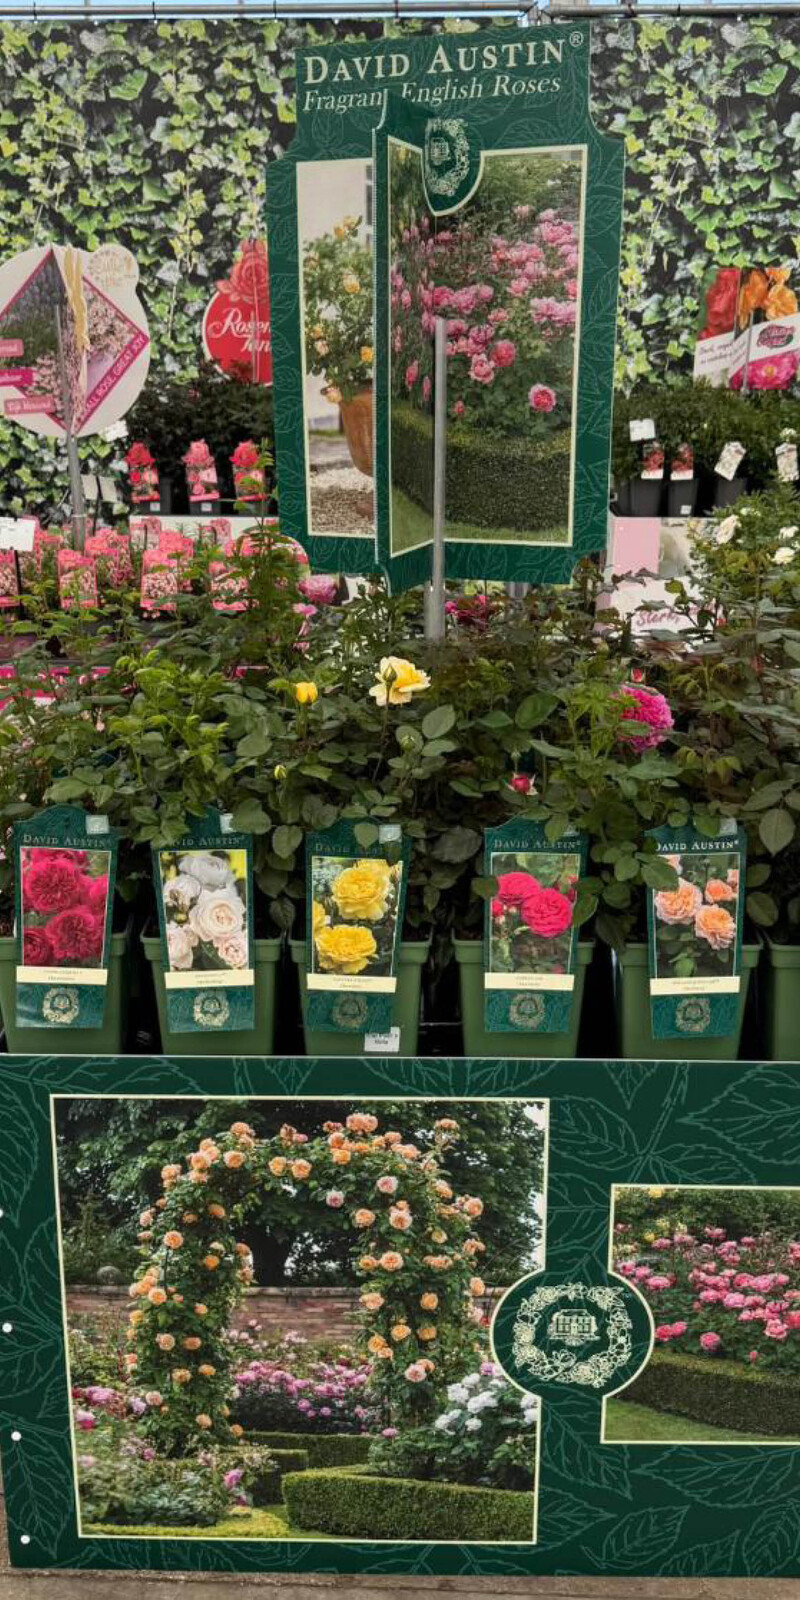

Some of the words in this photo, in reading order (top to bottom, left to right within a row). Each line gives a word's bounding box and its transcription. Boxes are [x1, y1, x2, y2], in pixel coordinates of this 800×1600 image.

[303, 54, 410, 85] DAVID
[302, 89, 383, 115] Fragran
[401, 77, 483, 108] English
[492, 74, 562, 98] Roses
[23, 834, 59, 845] DAVID
[494, 839, 529, 849] DAVID
